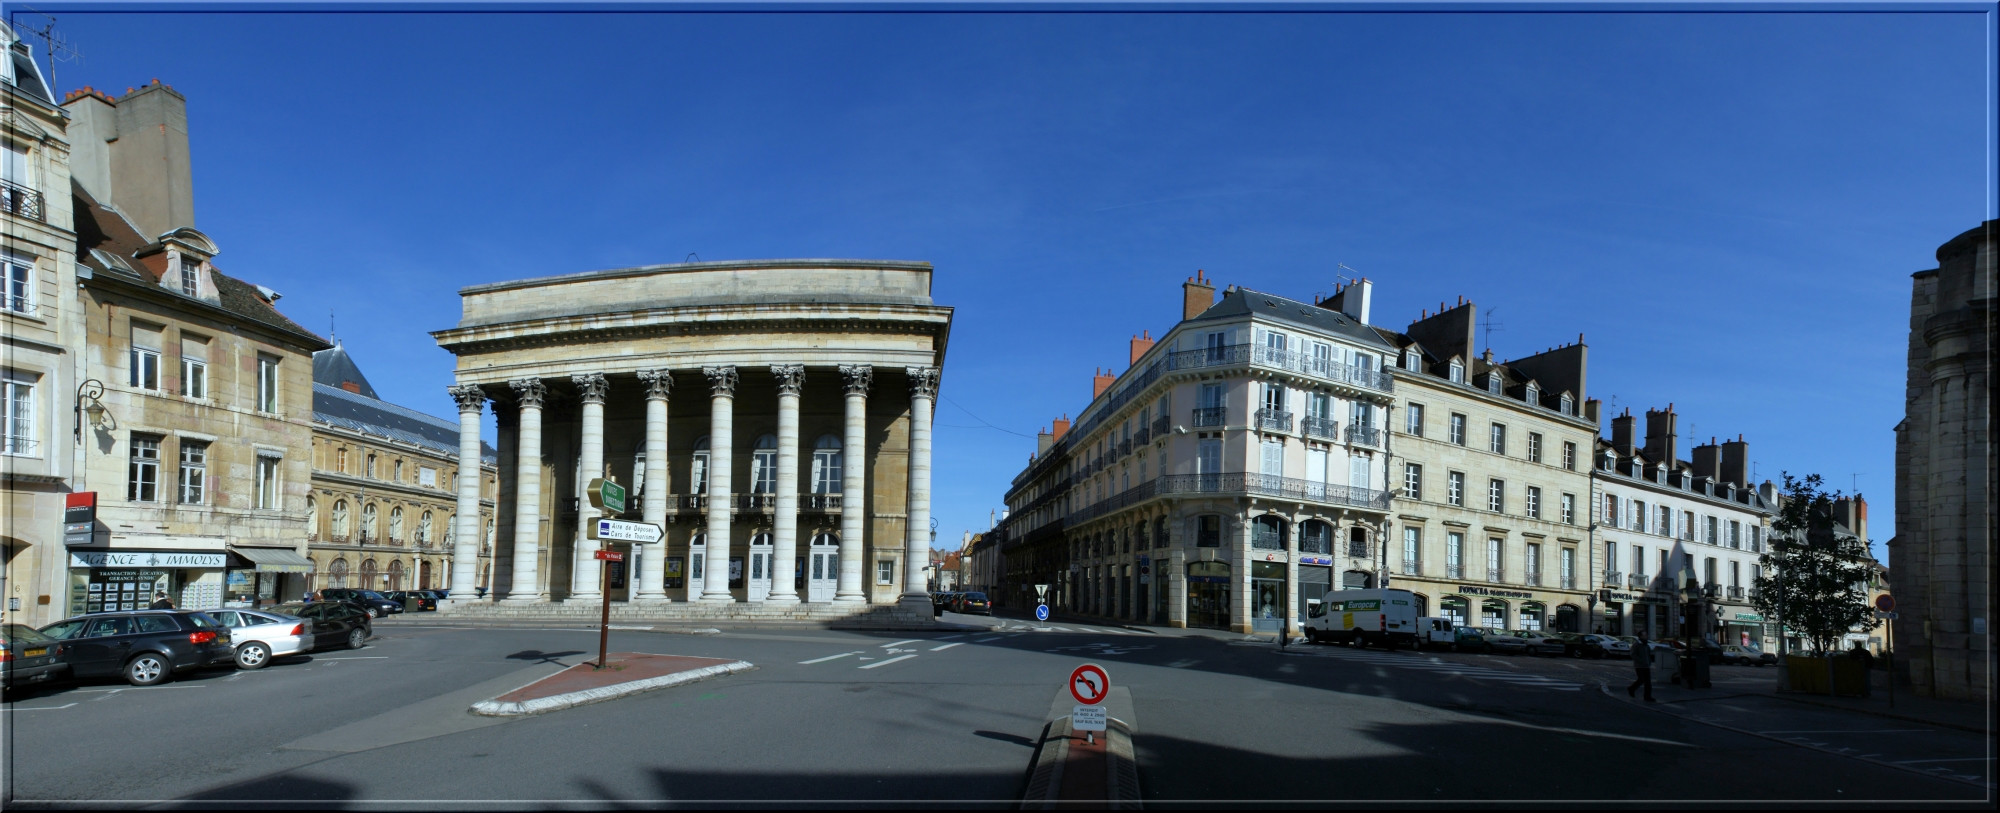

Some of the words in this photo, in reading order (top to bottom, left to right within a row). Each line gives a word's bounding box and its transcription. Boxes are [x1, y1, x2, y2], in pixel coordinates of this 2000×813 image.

[611, 530, 623, 538] Cars
[634, 532, 655, 541] Tourisme
[79, 554, 138, 565] AGENCE
[166, 555, 222, 565] IMMOLYS
[15, 584, 21, 593] 6
[1458, 585, 1489, 596] FONCIA
[1347, 600, 1377, 610] Europcar
